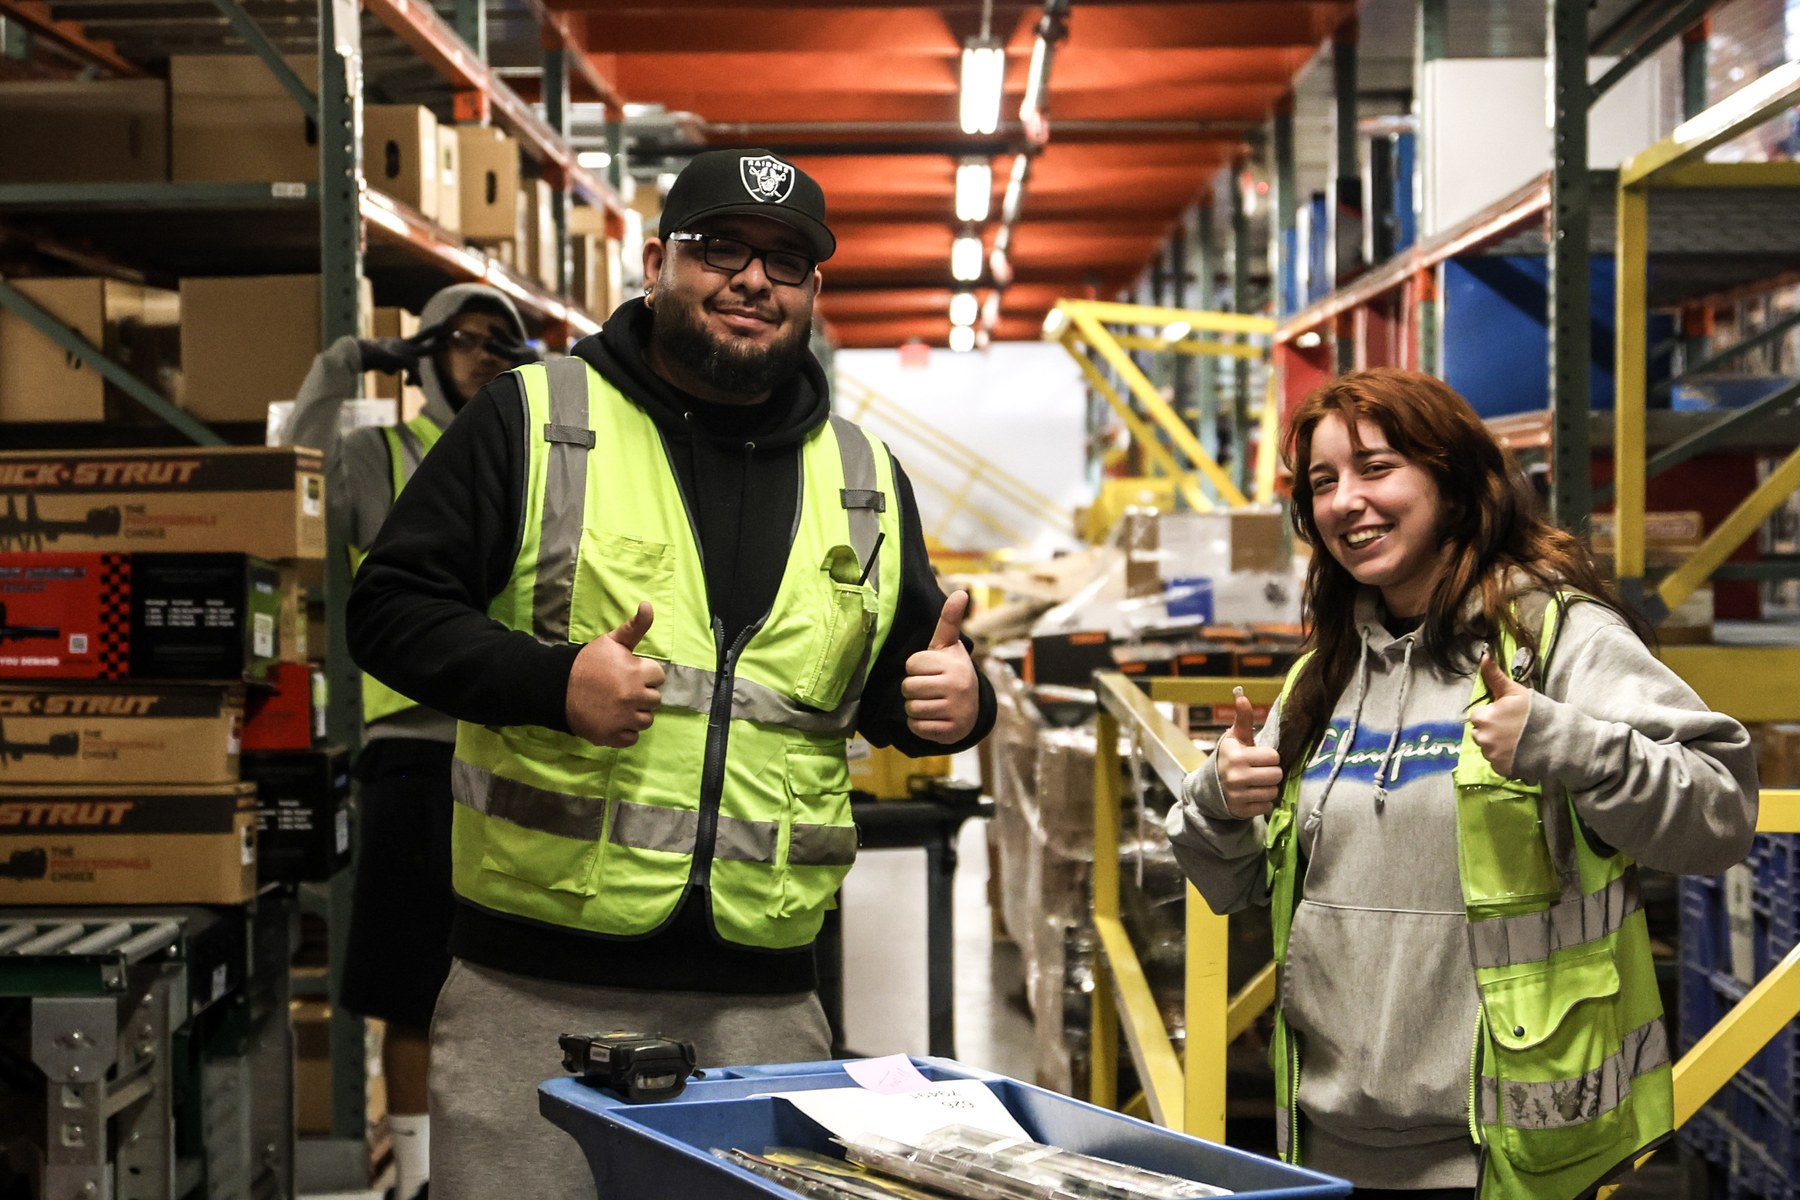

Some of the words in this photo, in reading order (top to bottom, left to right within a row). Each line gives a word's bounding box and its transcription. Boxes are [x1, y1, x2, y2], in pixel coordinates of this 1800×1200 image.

[747, 160, 789, 174] RAIDERS
[21, 657, 59, 666] DEMAND
[1306, 728, 1463, 782] Champion
